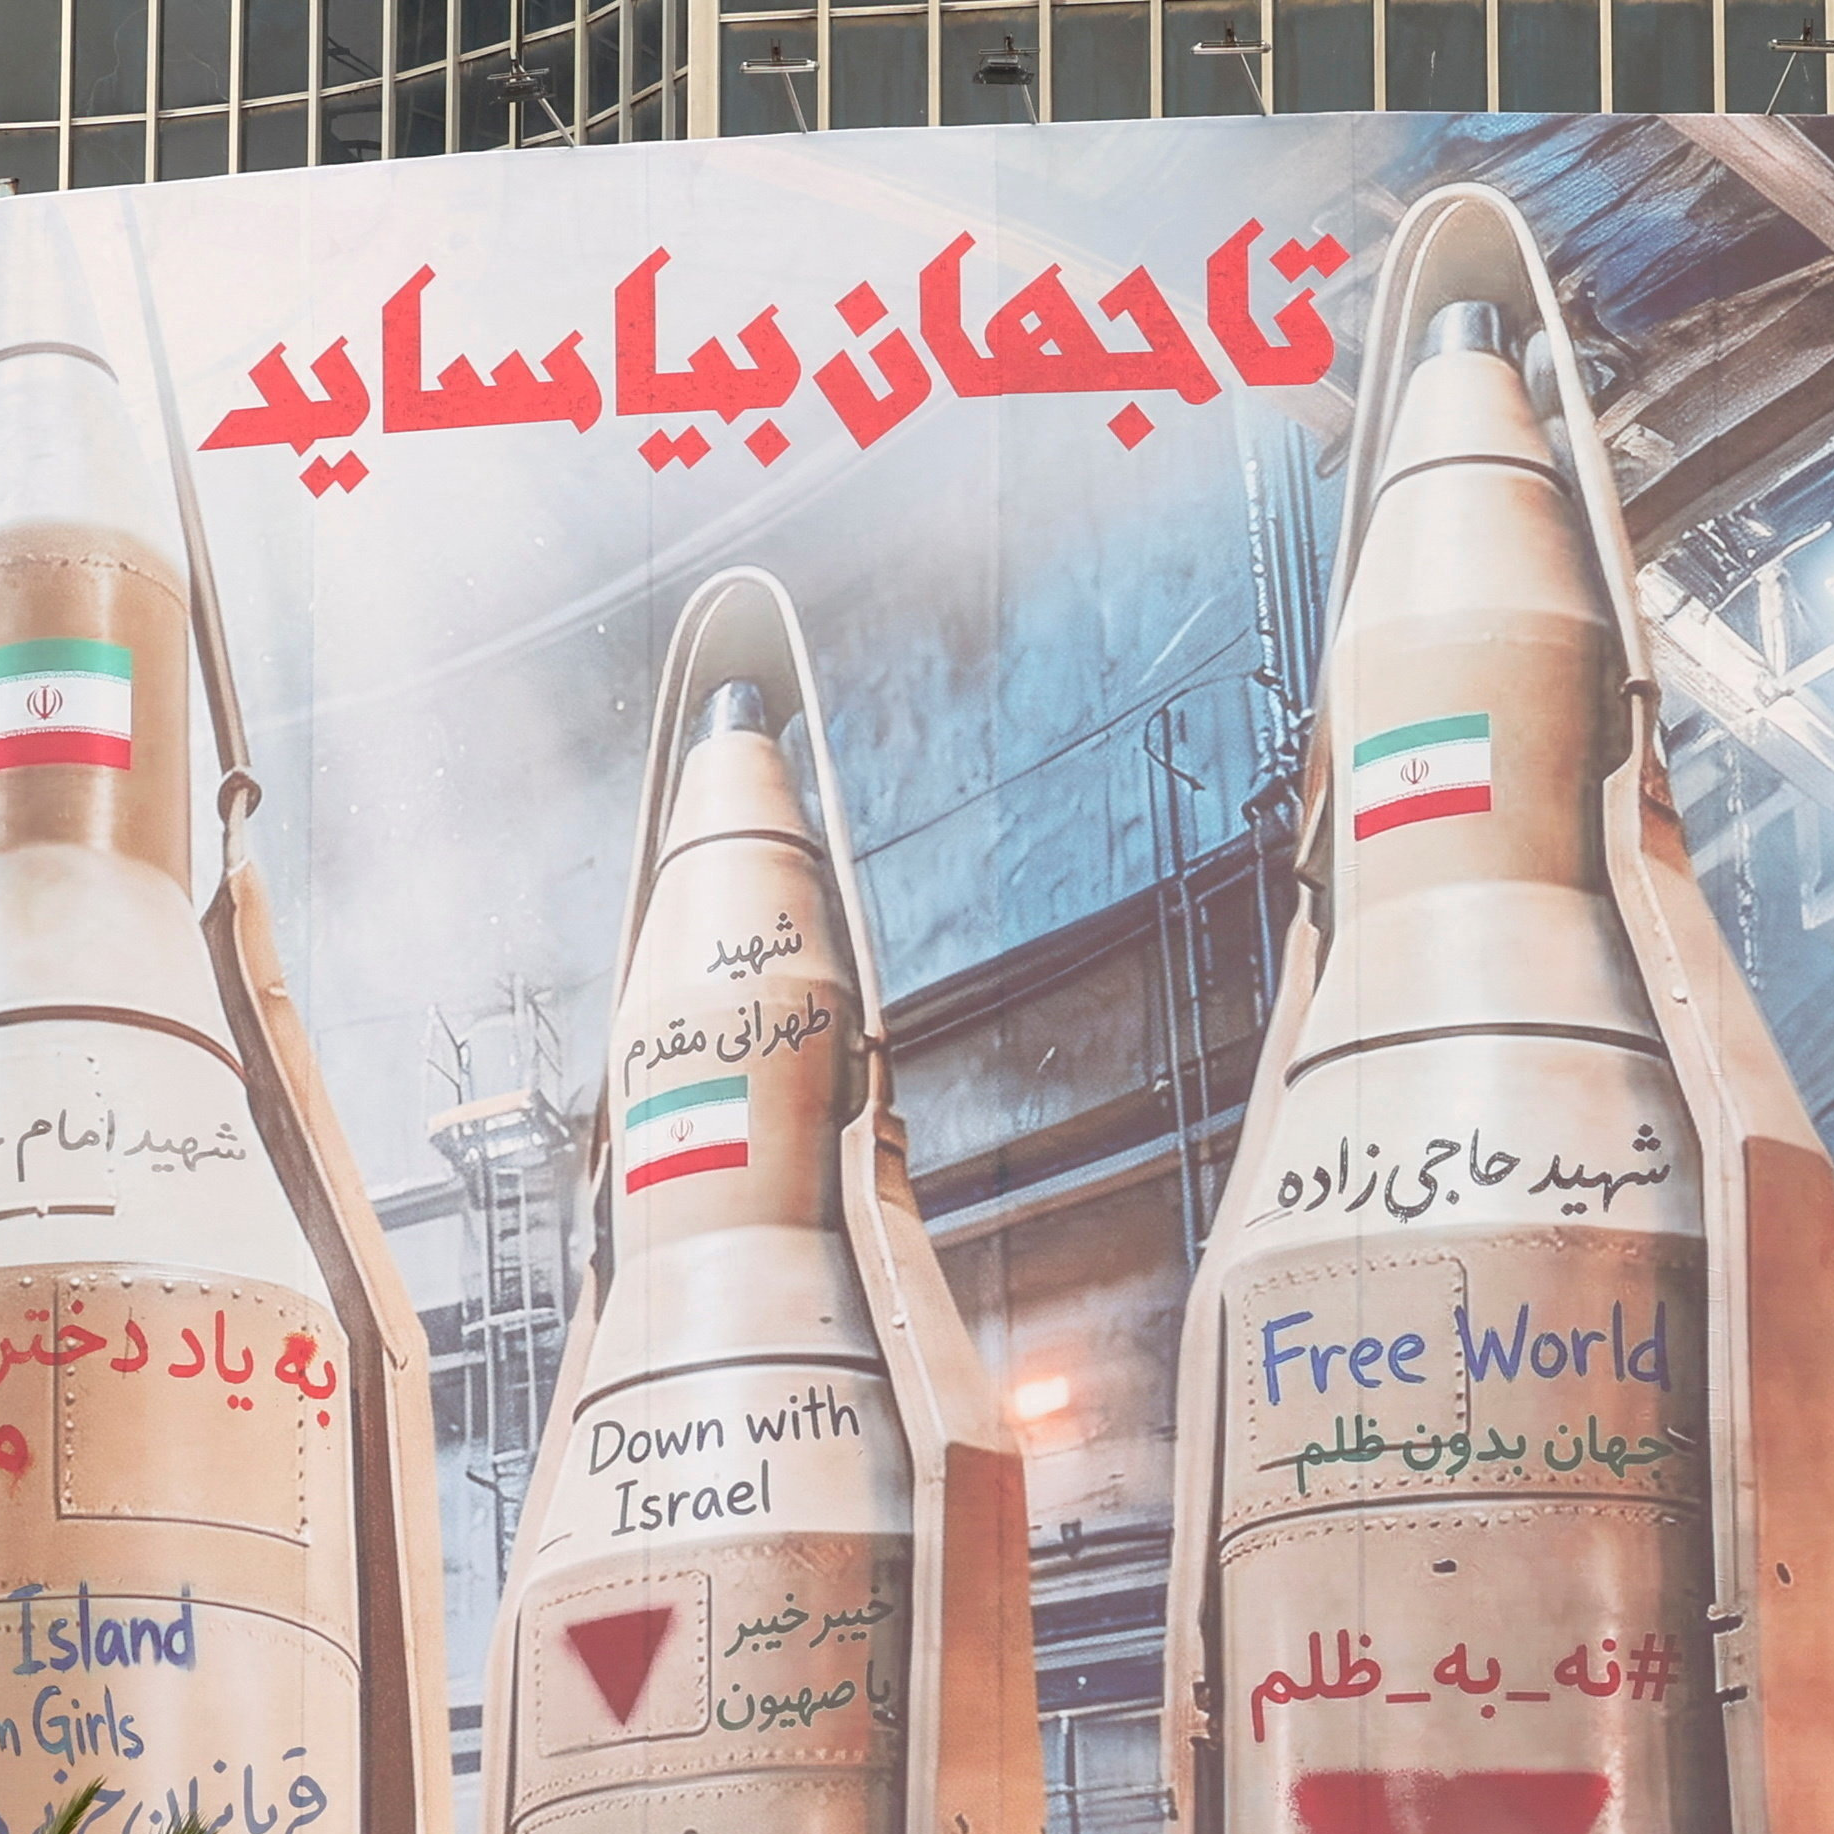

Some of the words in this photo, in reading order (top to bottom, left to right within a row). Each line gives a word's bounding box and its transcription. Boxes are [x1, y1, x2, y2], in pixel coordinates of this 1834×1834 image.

[811, 228, 1223, 454] جهان
[1205, 216, 1352, 388] تا
[712, 911, 803, 980] شهید
[623, 1020, 707, 1098] مقدم
[715, 992, 832, 1062] طهرانی
[15, 1108, 117, 1183] امام
[123, 1120, 248, 1174] شهید
[1528, 1124, 1672, 1216] شهید
[166, 1309, 256, 1412] یاد
[272, 1330, 339, 1430] به
[1257, 1309, 1429, 1406] Free
[1451, 1298, 1672, 1392] World
[588, 1418, 725, 1476] Down
[745, 1384, 861, 1443] with
[1290, 1414, 1387, 1496] ظلم
[1401, 1421, 1529, 1478] بدون
[1542, 1414, 1675, 1482] جهان
[610, 1458, 773, 1537] Israel
[12, 1580, 198, 1674] Island
[31, 1685, 146, 1764] Girls
[715, 1673, 858, 1732] صهیون
